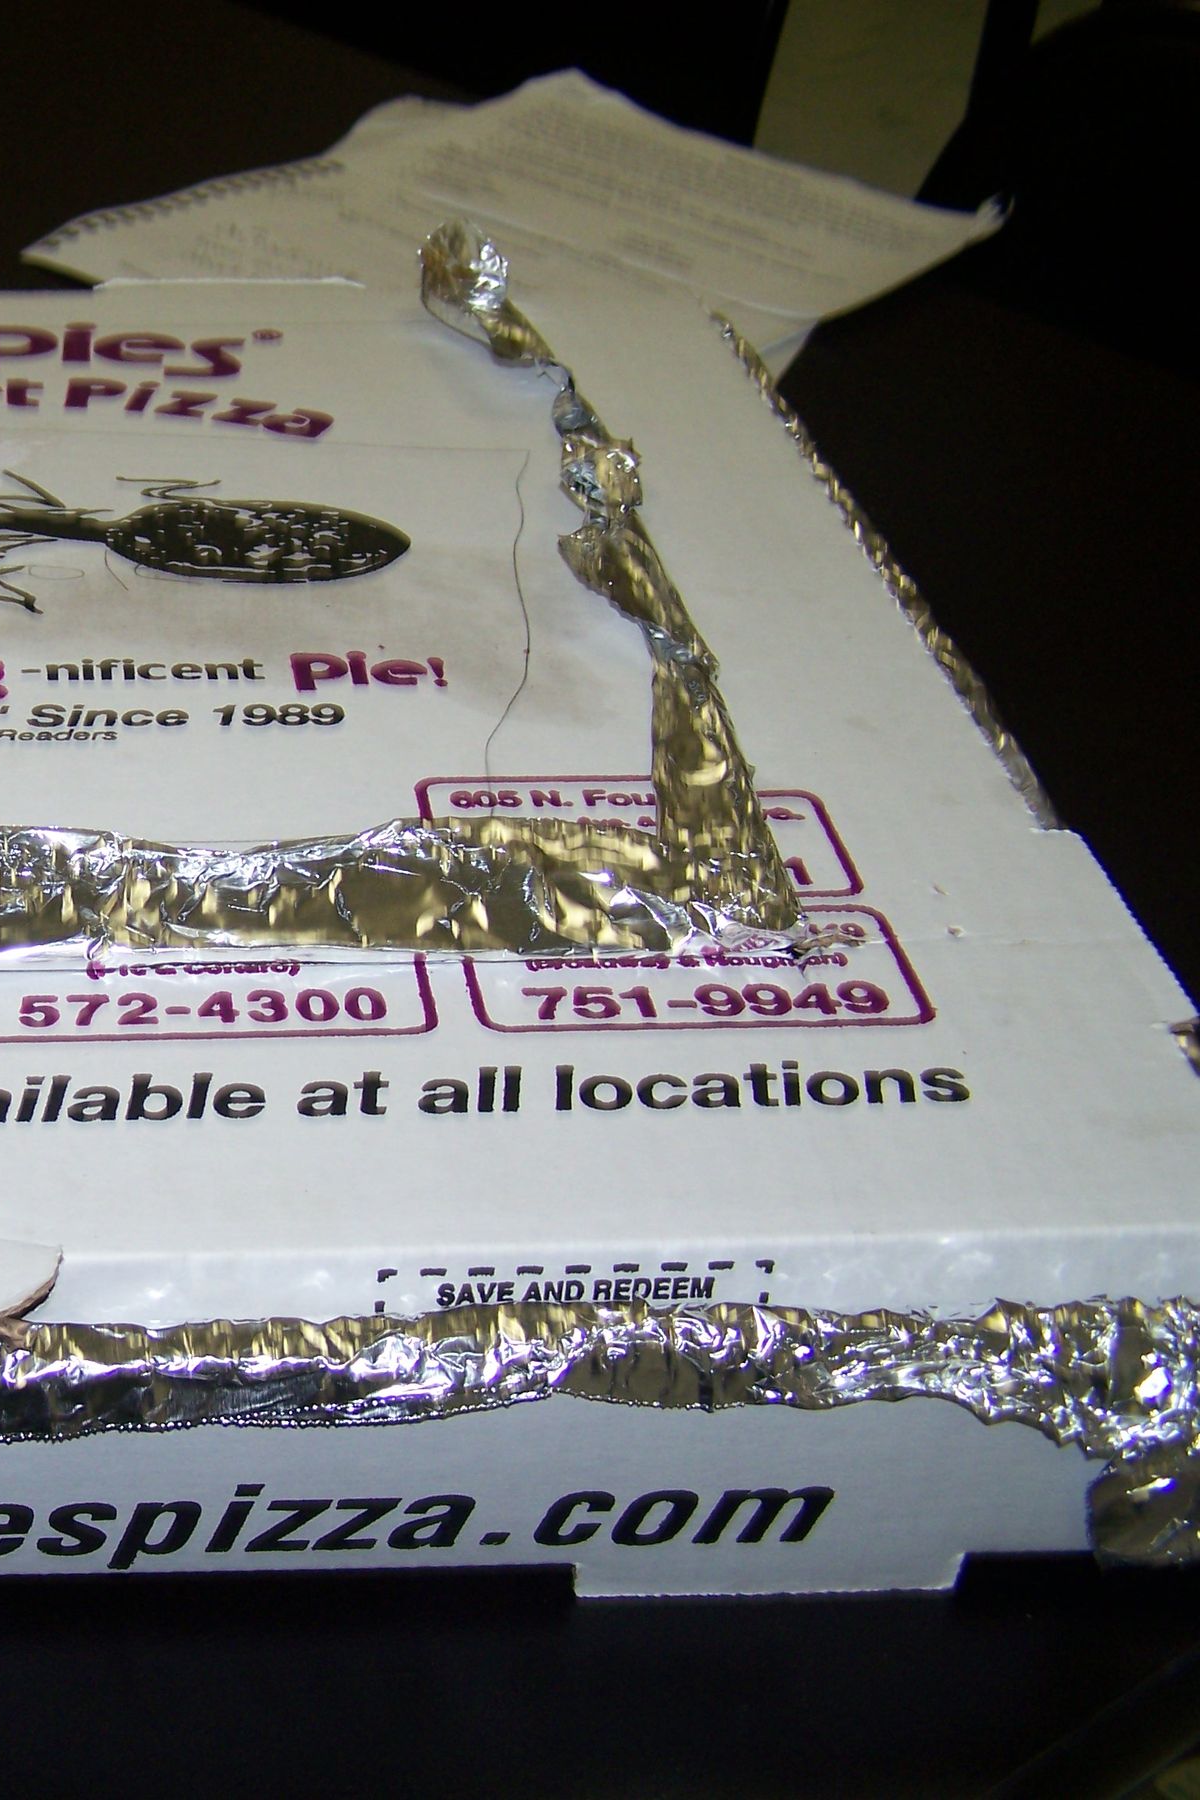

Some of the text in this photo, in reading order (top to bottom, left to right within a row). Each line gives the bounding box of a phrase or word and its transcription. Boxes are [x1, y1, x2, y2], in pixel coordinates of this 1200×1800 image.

[66, 377, 335, 438] Pizza
[290, 651, 448, 691] Pie!
[26, 703, 189, 727] Since
[212, 703, 346, 727] 1989
[529, 790, 574, 807] N.
[18, 987, 387, 1028] 572-4300
[521, 980, 890, 1020] 751-9949
[297, 1071, 390, 1118] at
[418, 1065, 522, 1114] all
[555, 1060, 971, 1111] locations
[436, 1277, 715, 1307] SAVE AND REDEEM
